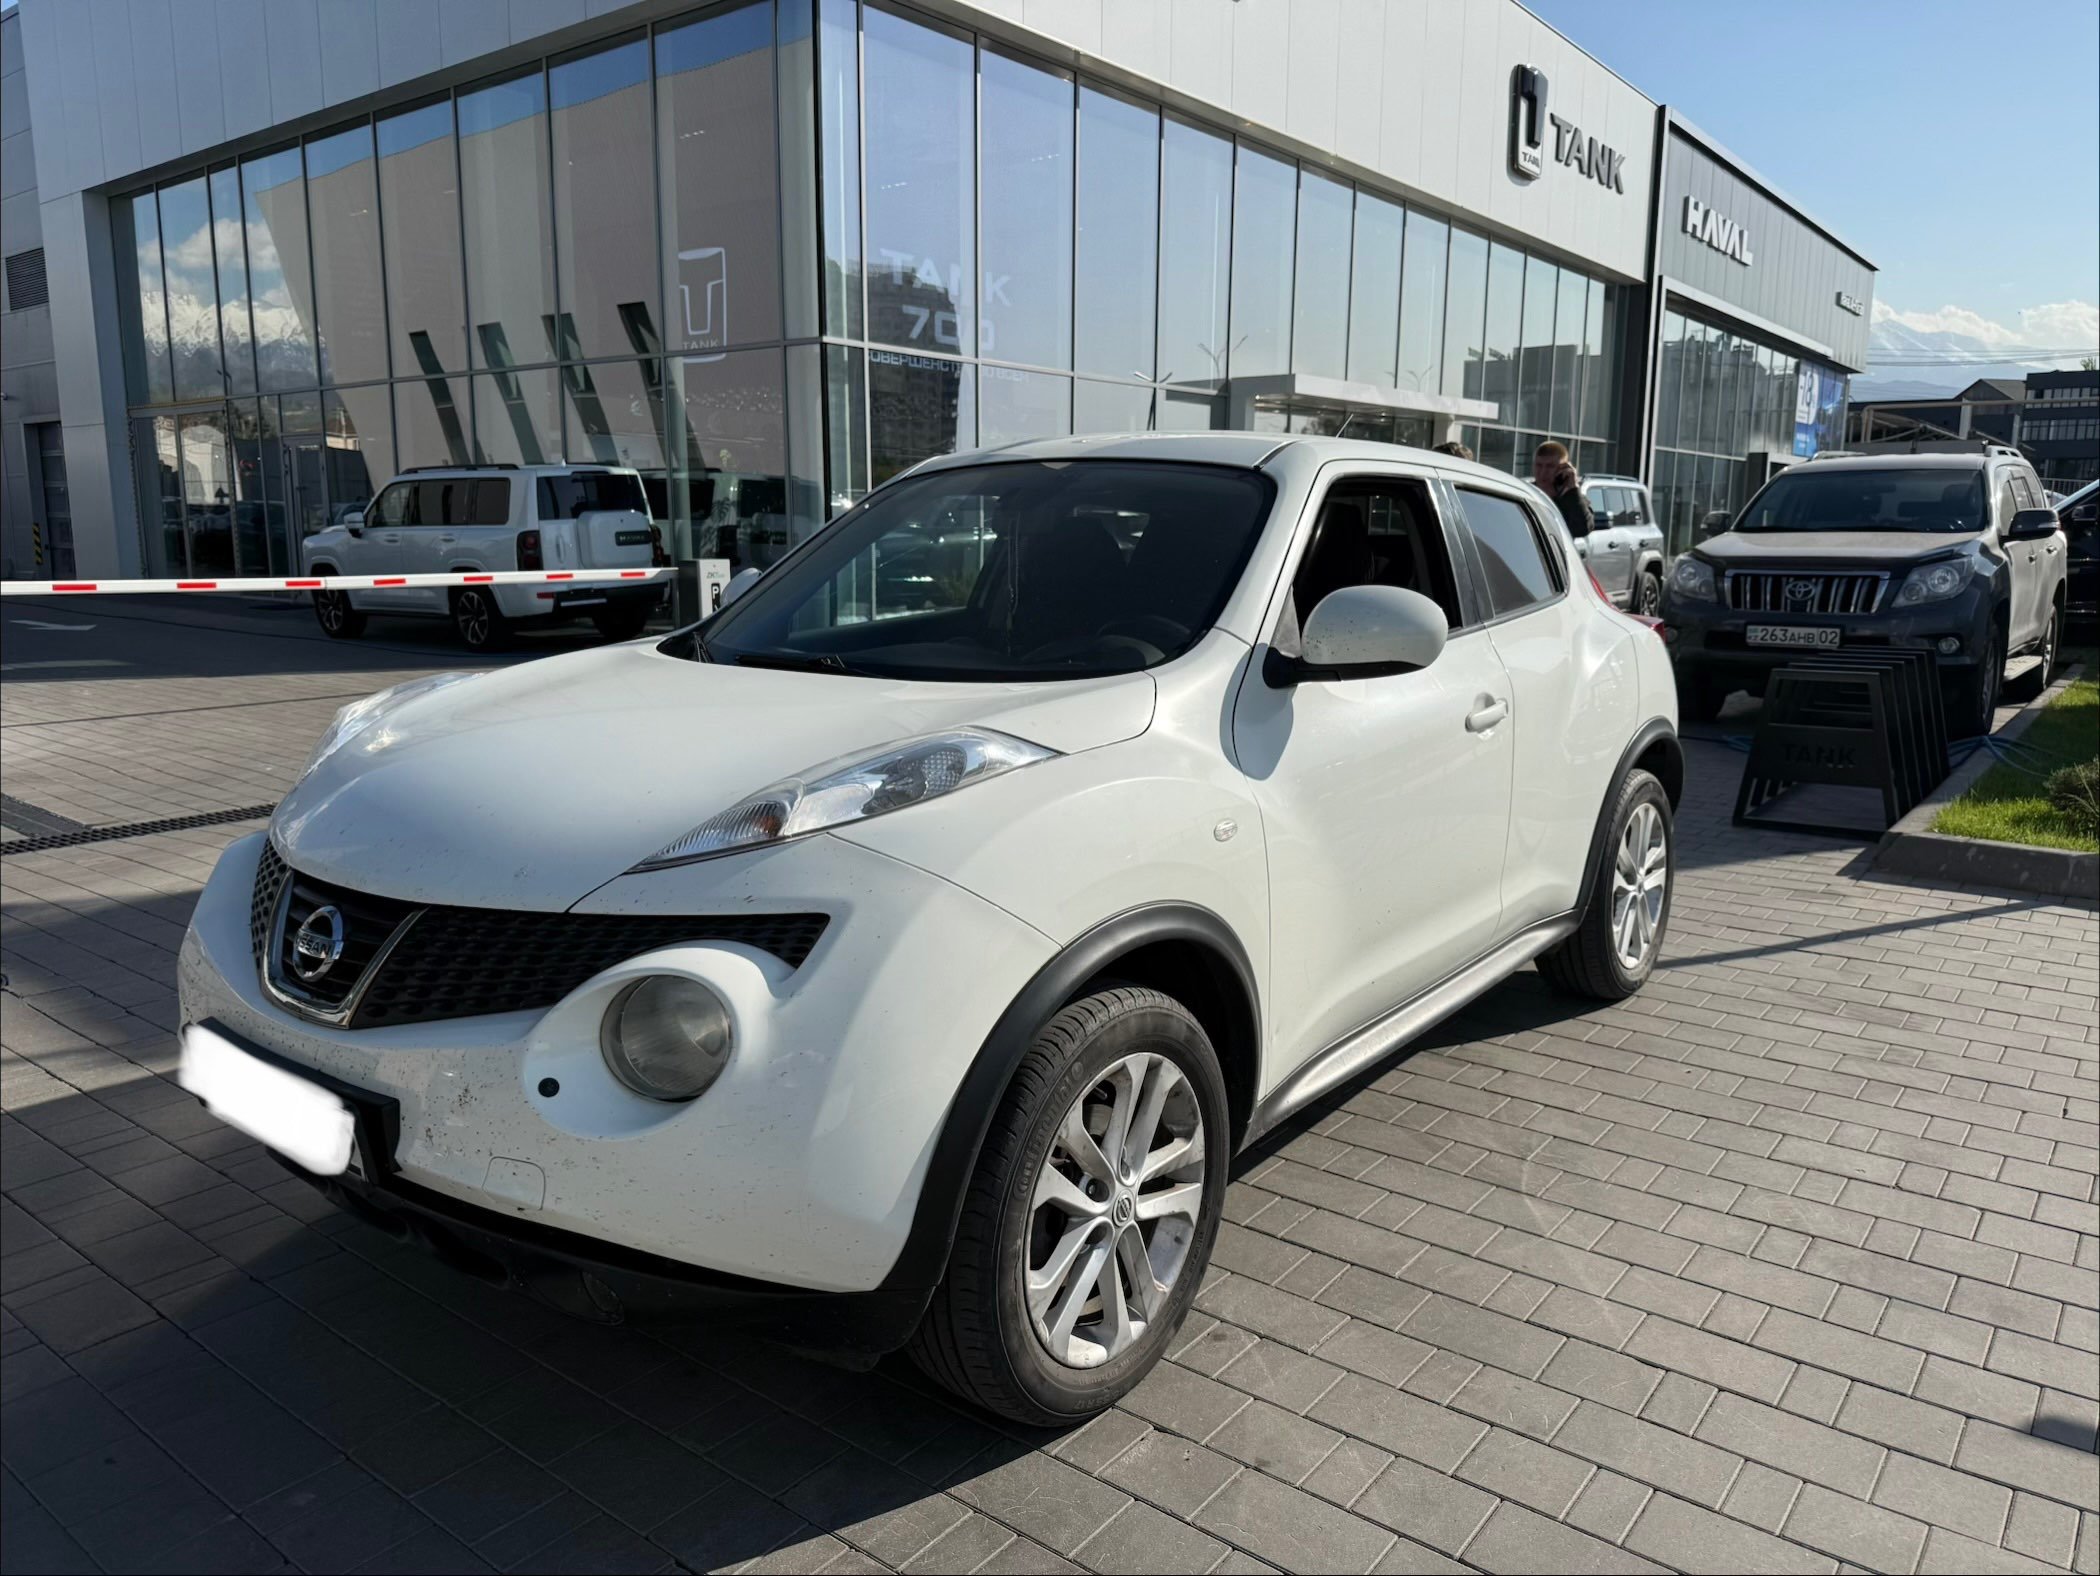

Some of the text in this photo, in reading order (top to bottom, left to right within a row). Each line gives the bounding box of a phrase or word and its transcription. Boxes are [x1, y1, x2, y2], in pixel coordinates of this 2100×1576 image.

[1549, 112, 1626, 194] TANK
[1683, 195, 1754, 267] HAVAL
[879, 247, 1012, 307] TANK
[682, 338, 719, 351] TANK
[1779, 743, 1857, 768] TANK
